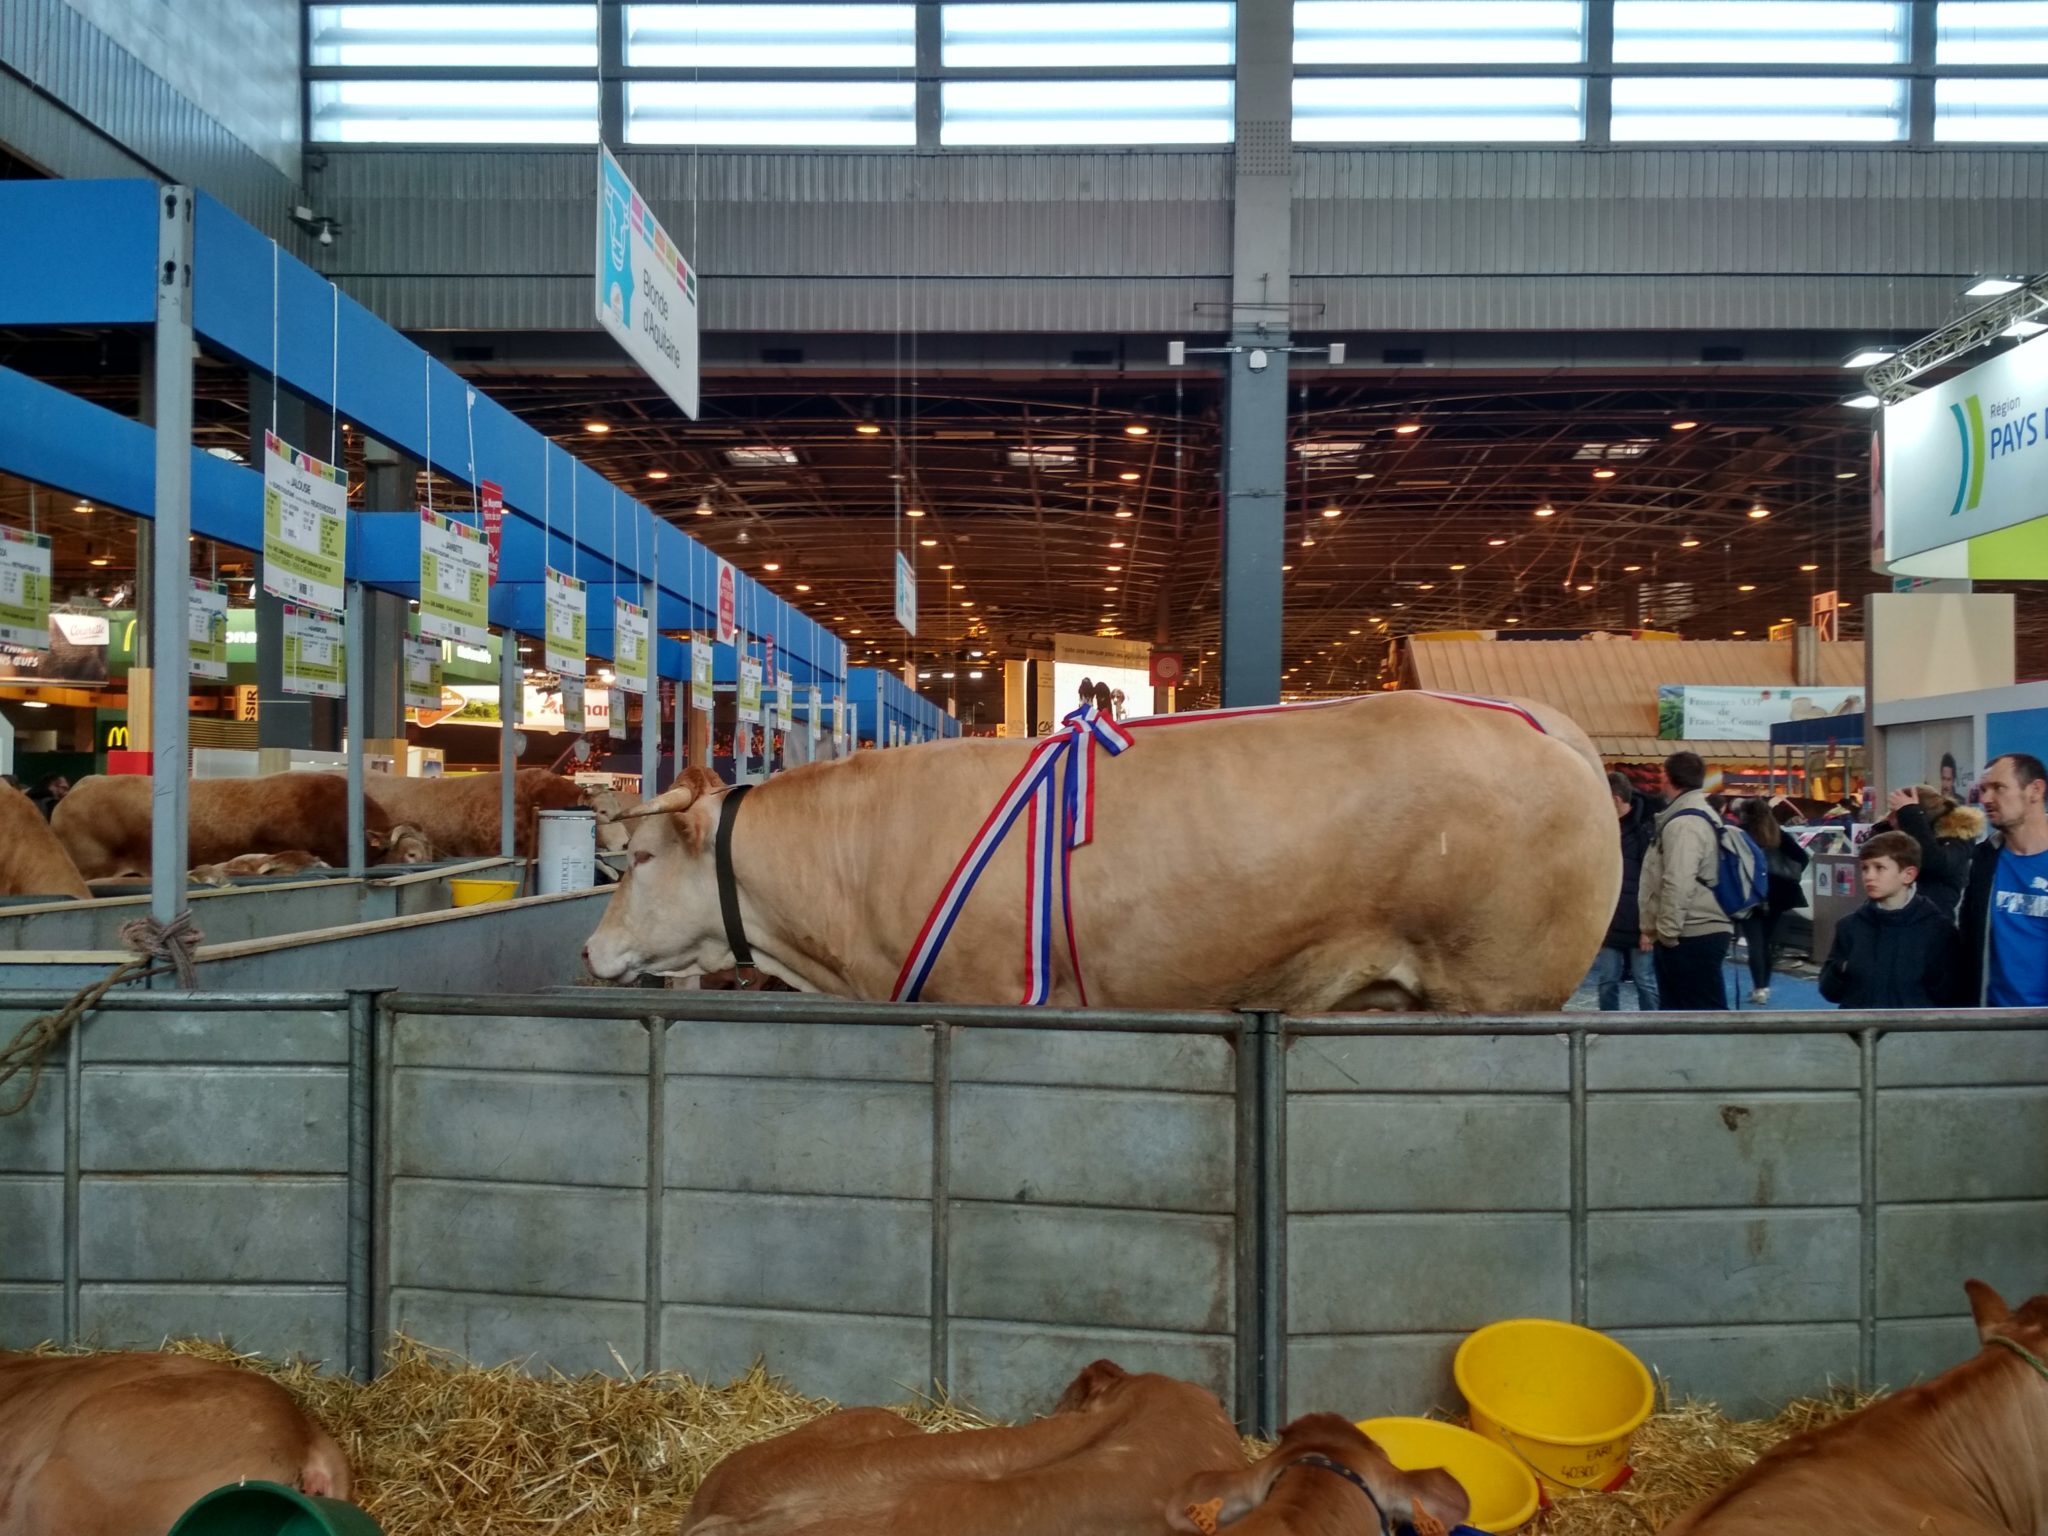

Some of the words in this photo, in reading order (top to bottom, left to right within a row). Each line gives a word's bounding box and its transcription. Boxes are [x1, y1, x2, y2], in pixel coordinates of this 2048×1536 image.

[643, 268, 669, 321] Blonde
[643, 307, 681, 369] d'Aquitaine
[1990, 396, 2021, 419] Région
[1990, 412, 2038, 460] PAYS
